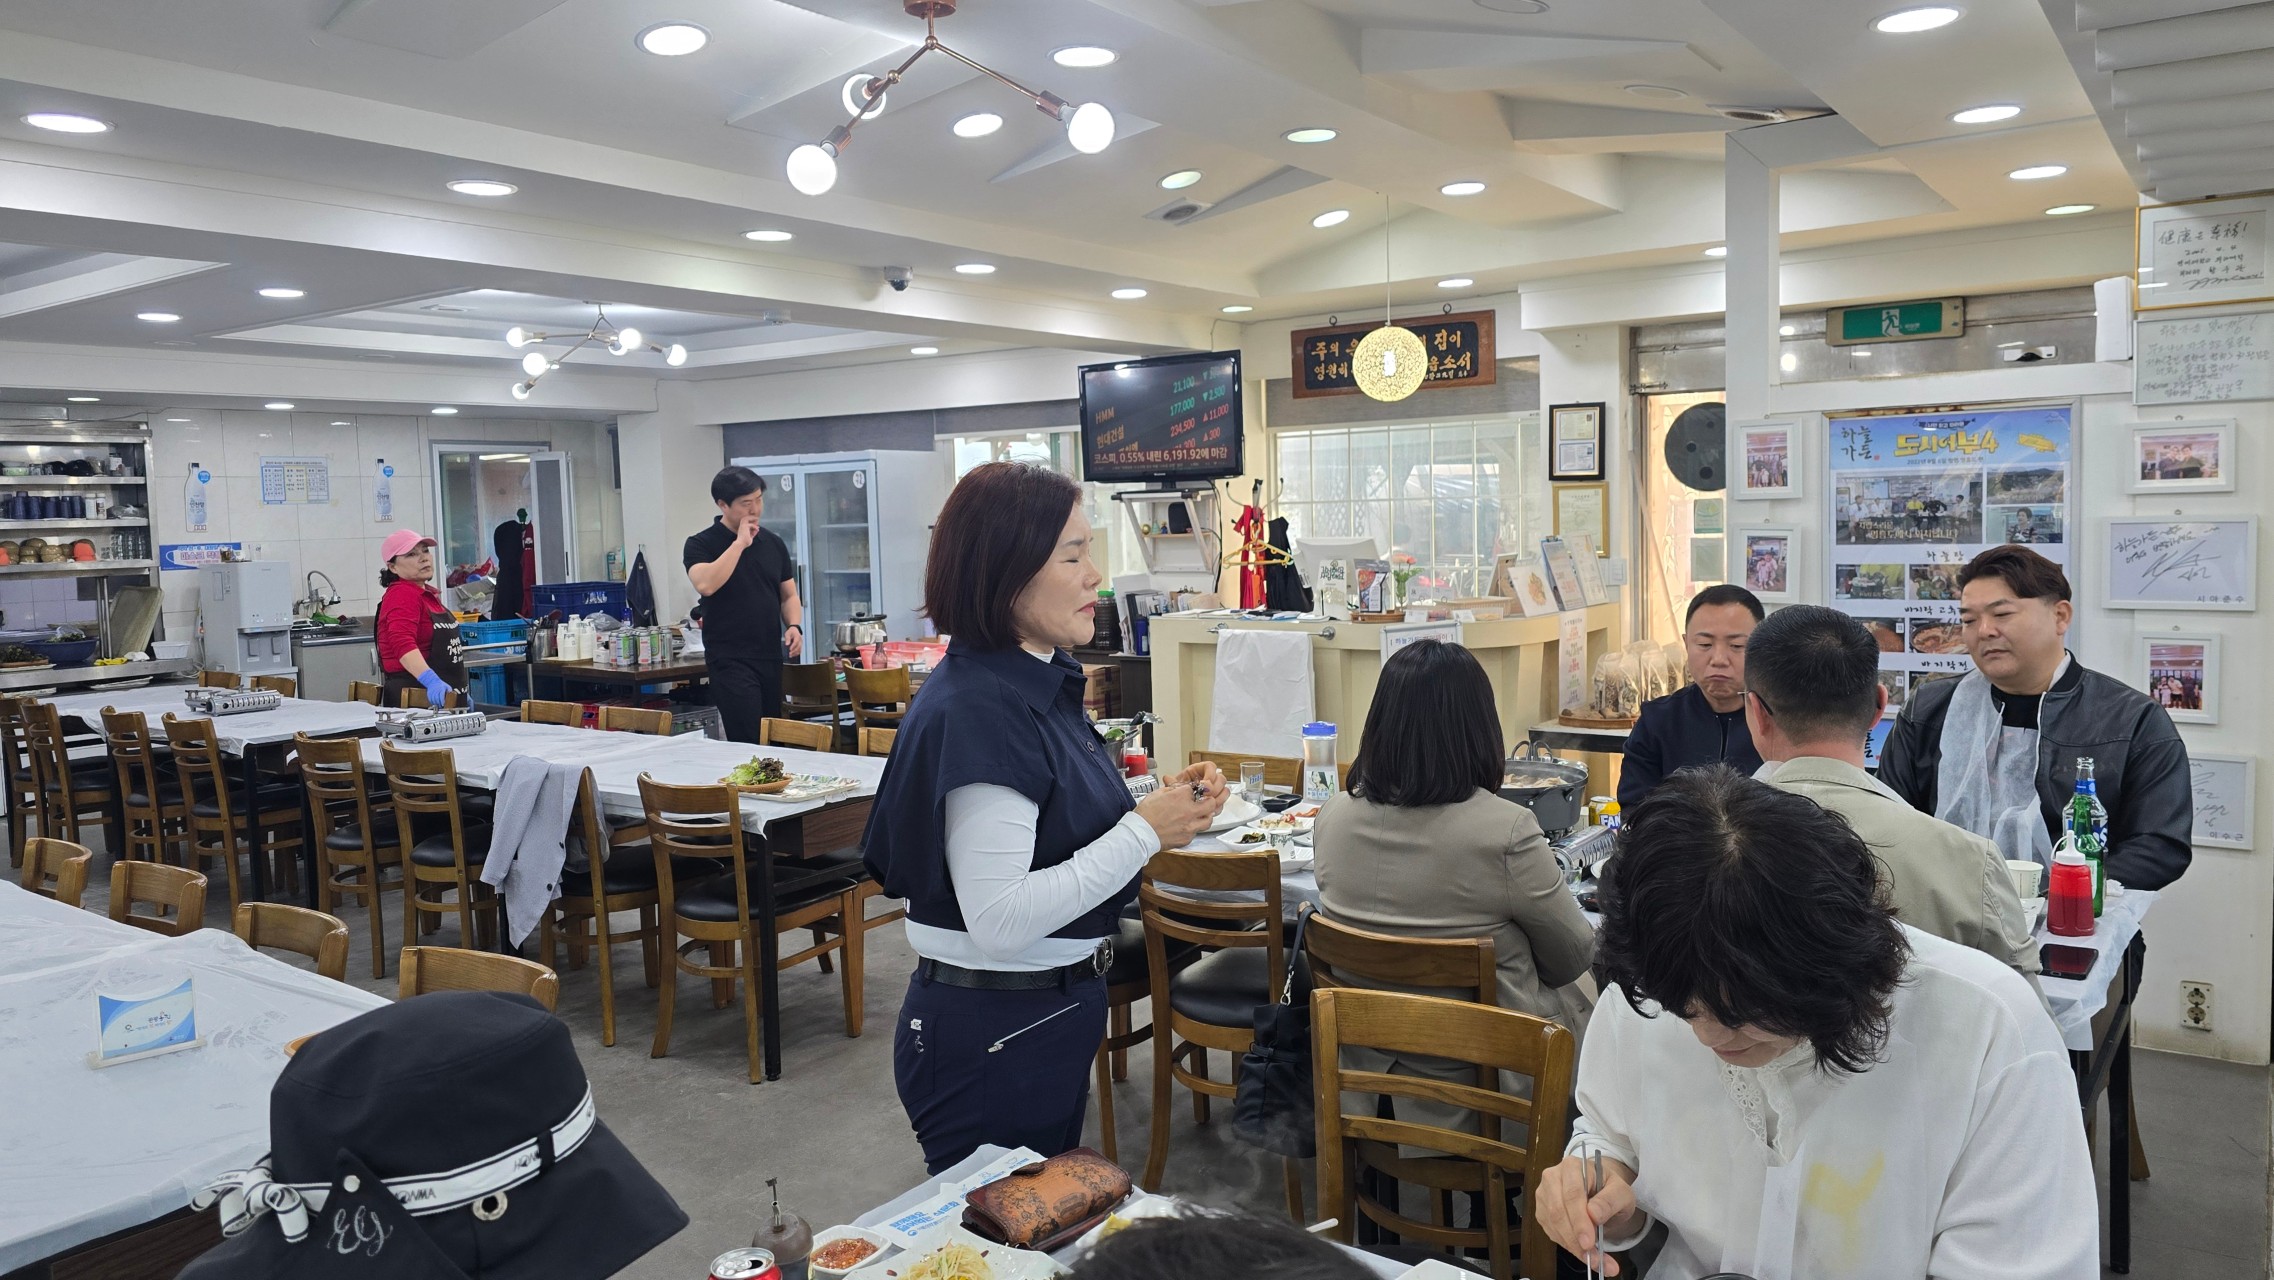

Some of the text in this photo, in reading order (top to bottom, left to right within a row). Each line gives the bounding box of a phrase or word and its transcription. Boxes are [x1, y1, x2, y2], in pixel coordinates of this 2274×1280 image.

[1311, 341, 1339, 361] 주의
[1433, 329, 1461, 351] 집이
[1313, 361, 1348, 381] 영원히
[1095, 406, 1115, 425] HMM
[1841, 425, 1873, 444] 하늘
[1893, 429, 1999, 457] 도시어부4
[1093, 452, 1118, 465] 코스피,
[1119, 451, 1145, 464] 0.55%
[1146, 450, 1162, 463] 내린
[1211, 446, 1228, 460] 마감
[1841, 444, 1872, 462] 가든
[1904, 605, 1962, 616] 바지락 고추
